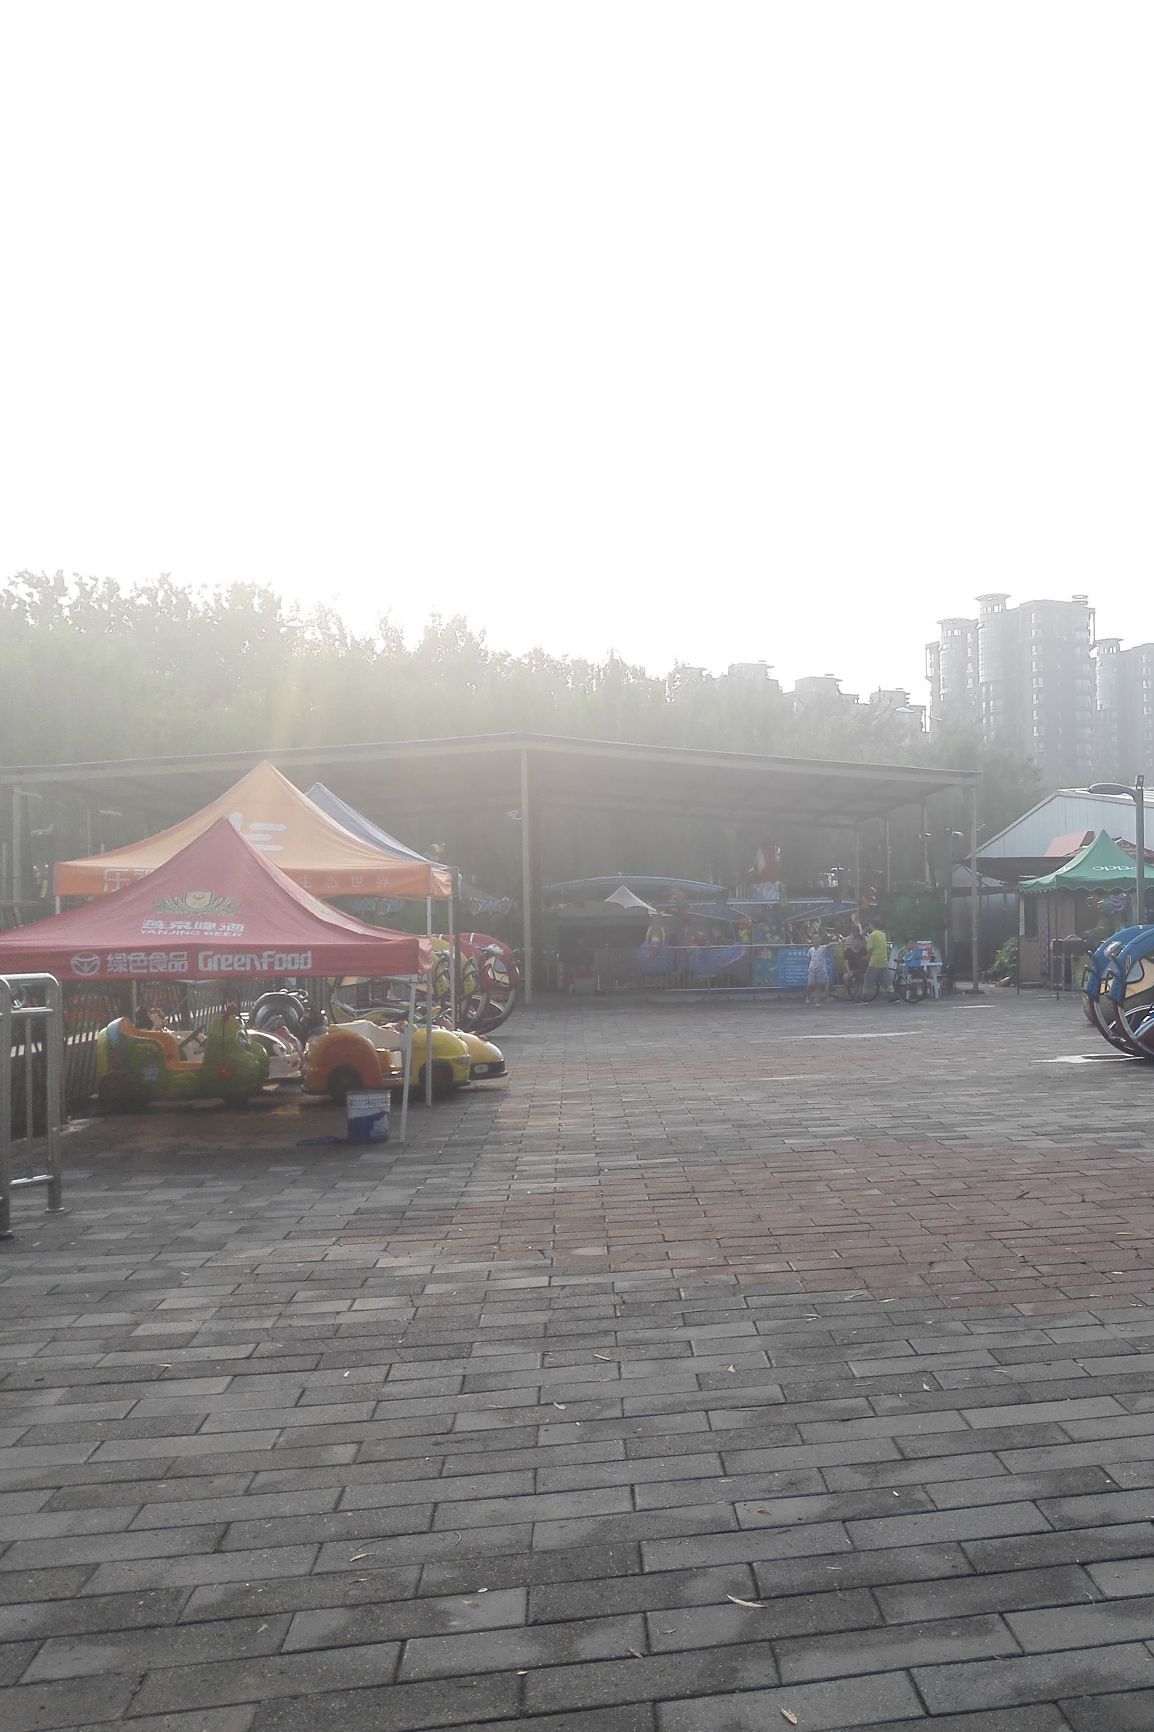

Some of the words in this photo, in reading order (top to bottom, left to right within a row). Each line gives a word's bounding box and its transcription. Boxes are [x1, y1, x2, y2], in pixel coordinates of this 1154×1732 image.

[142, 919, 245, 932] 燕京啤酒
[106, 952, 188, 973] 绿色食品
